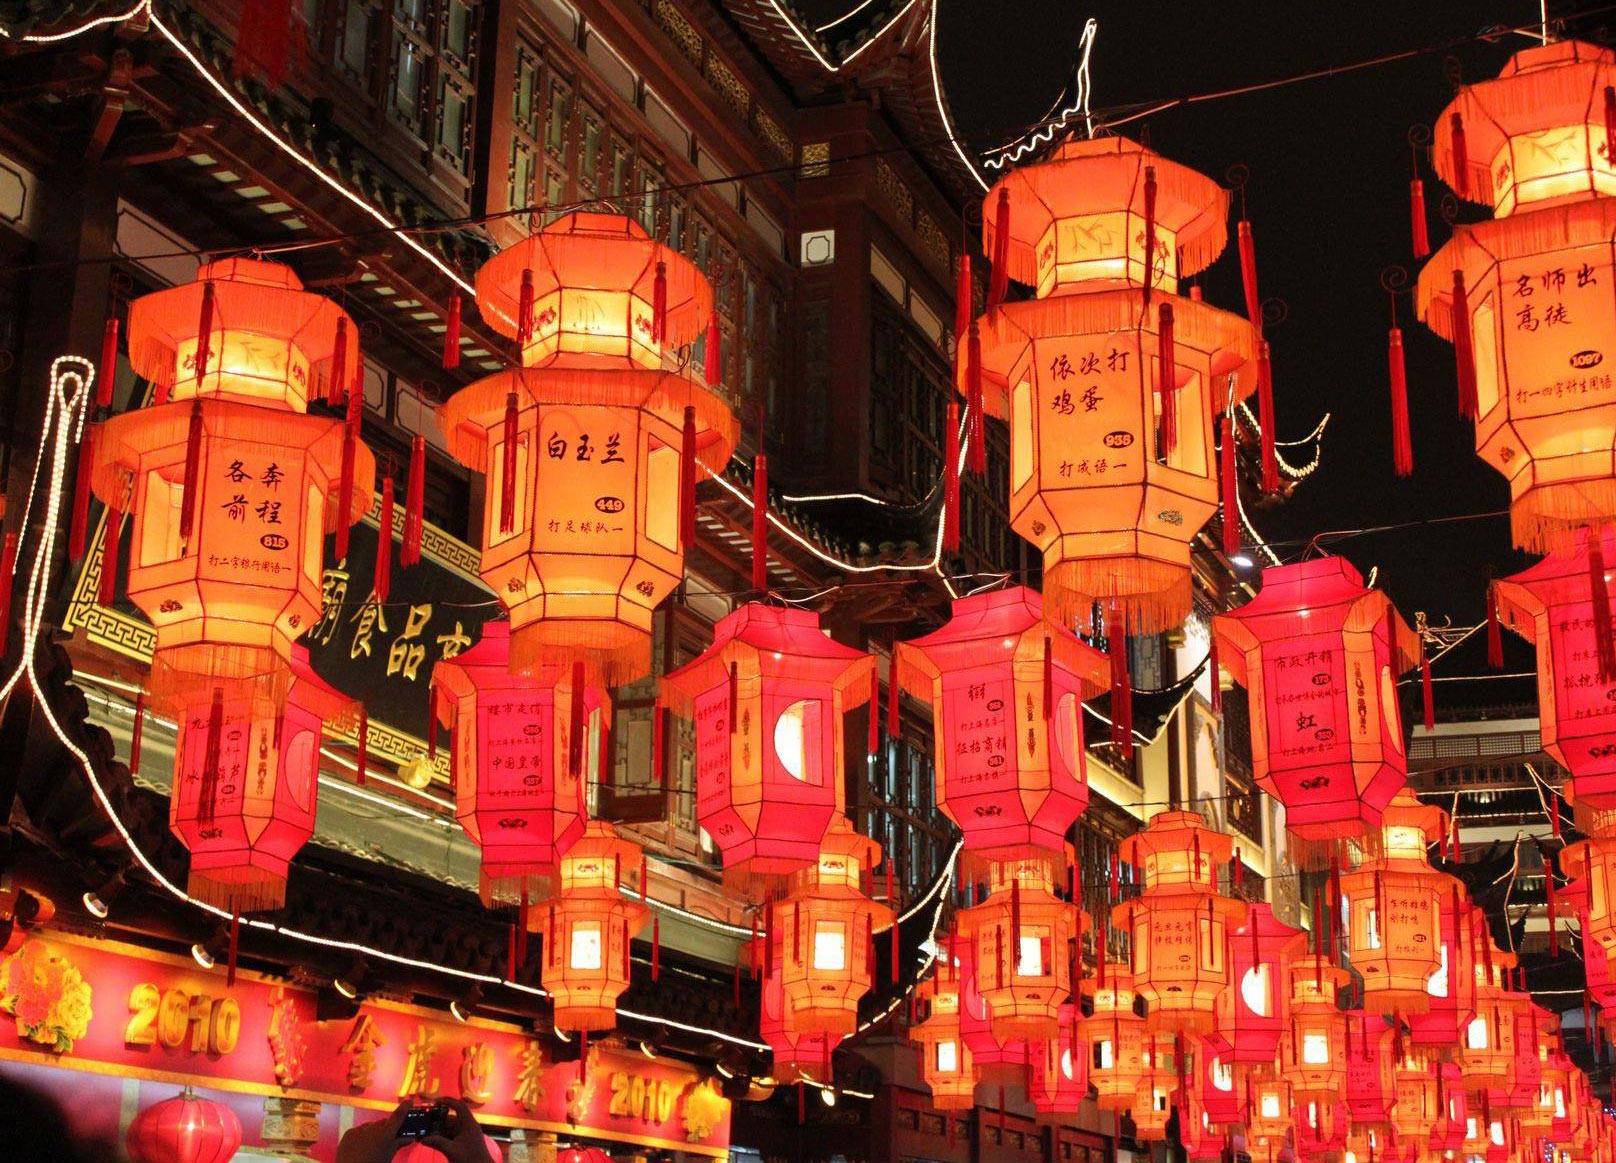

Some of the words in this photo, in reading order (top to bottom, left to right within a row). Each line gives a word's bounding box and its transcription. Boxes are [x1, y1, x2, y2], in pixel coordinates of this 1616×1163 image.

[1512, 263, 1598, 298] 名师出
[1515, 302, 1573, 332] 高徒
[1050, 348, 1130, 381] 依次打
[1051, 385, 1104, 415] 鸡蛋
[547, 432, 625, 464] 白玉兰
[224, 458, 285, 492] 各奔
[1059, 457, 1127, 478] 打成语一
[221, 494, 282, 525] 前程
[548, 518, 624, 534] 打足球队一
[125, 982, 241, 1055] 2010
[609, 1072, 673, 1123] 2010
